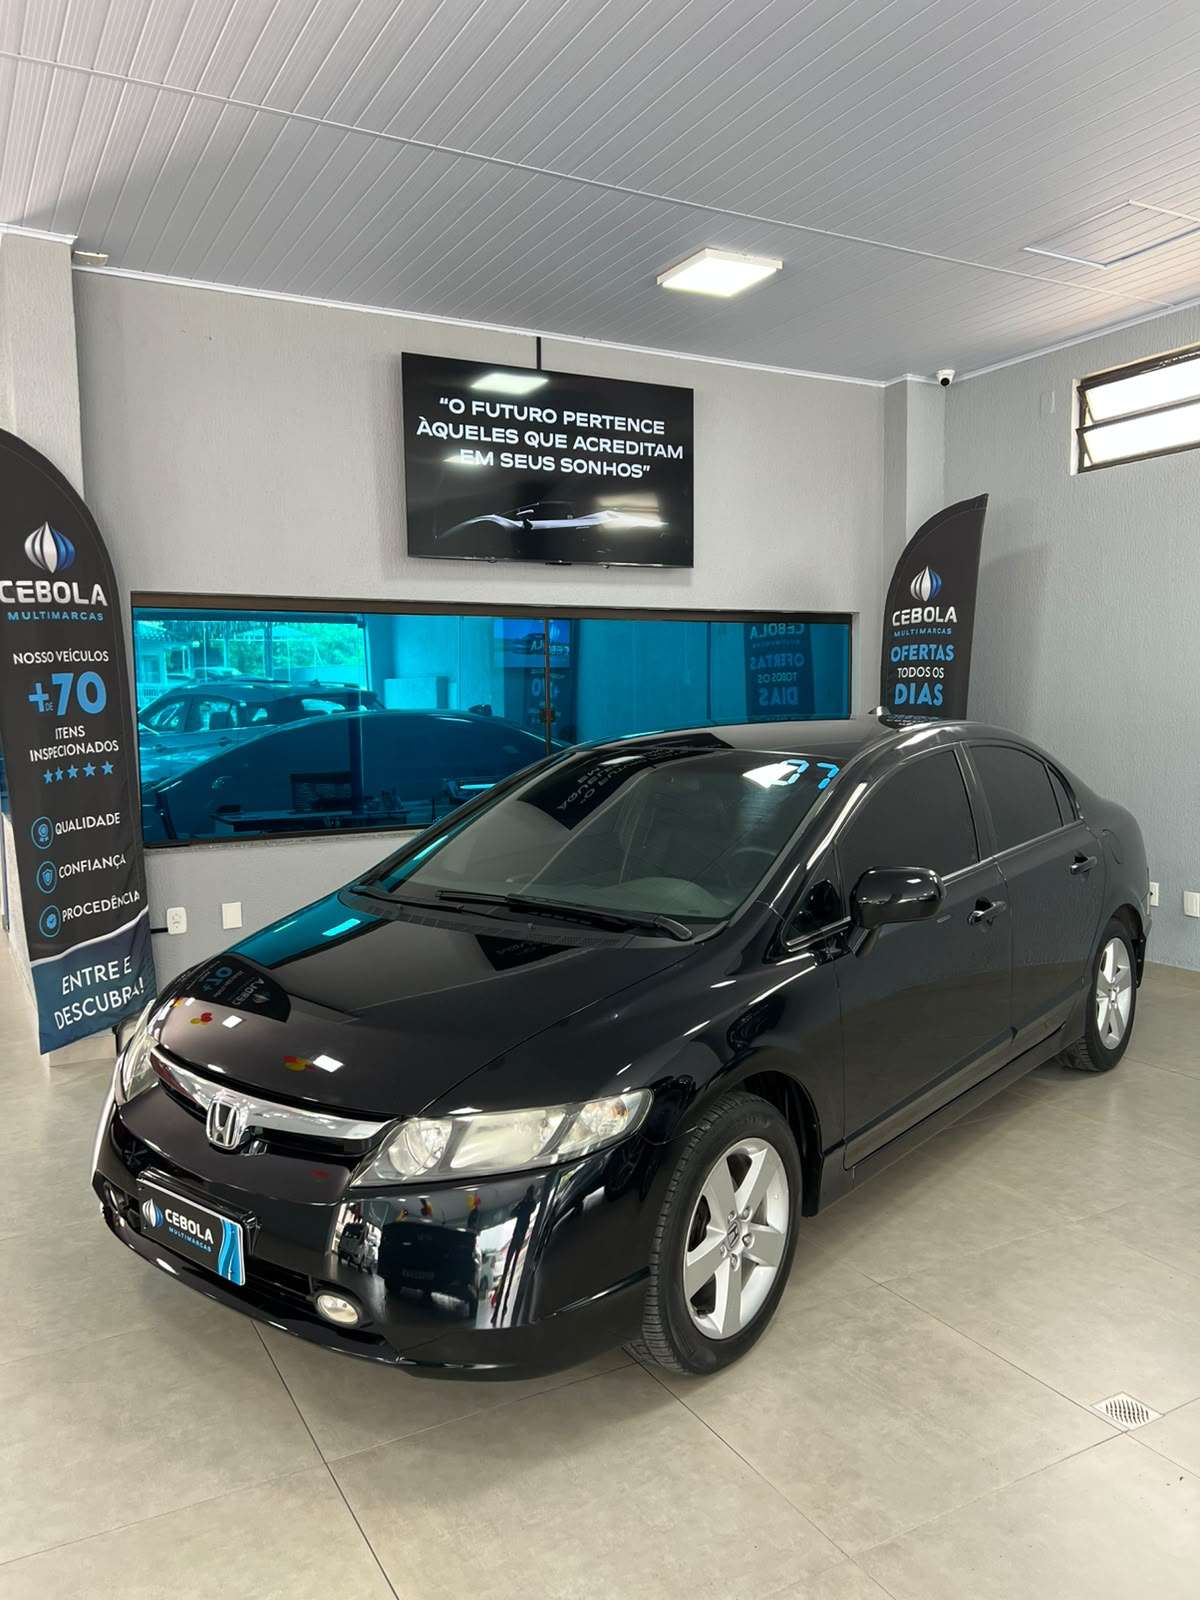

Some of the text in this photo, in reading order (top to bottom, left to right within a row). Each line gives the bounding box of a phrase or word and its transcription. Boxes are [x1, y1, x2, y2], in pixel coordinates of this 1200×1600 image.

[472, 400, 557, 425] FUTURO
[563, 410, 665, 435] PERTENCE
[416, 416, 683, 459] ÀQUELES QUE ACREDITAM
[460, 448, 650, 478] EM SEUS SONHOS”
[0, 580, 108, 606] CEBOLA
[8, 611, 104, 621] MULTIMARCAS
[892, 606, 958, 626] CEBOLA
[894, 628, 952, 637] MULTIMARCAS
[13, 648, 110, 665] NOSSO VEÍCULOS
[890, 644, 955, 662] OFERTAS
[897, 667, 945, 679] TODOS OS
[894, 682, 944, 706] DIAS
[55, 725, 86, 740] ITENS
[29, 740, 119, 762] INSPECIONADOS
[55, 812, 120, 836] QUALIDADE
[58, 854, 127, 879] CONFIANÇA
[62, 890, 140, 923] PROCEDÊNCIA
[62, 955, 132, 995] ENTRE E
[54, 977, 144, 1030] DESCUBRA!
[164, 1208, 214, 1245] CEBOLA
[168, 1226, 212, 1252] MULTIMARCAS
